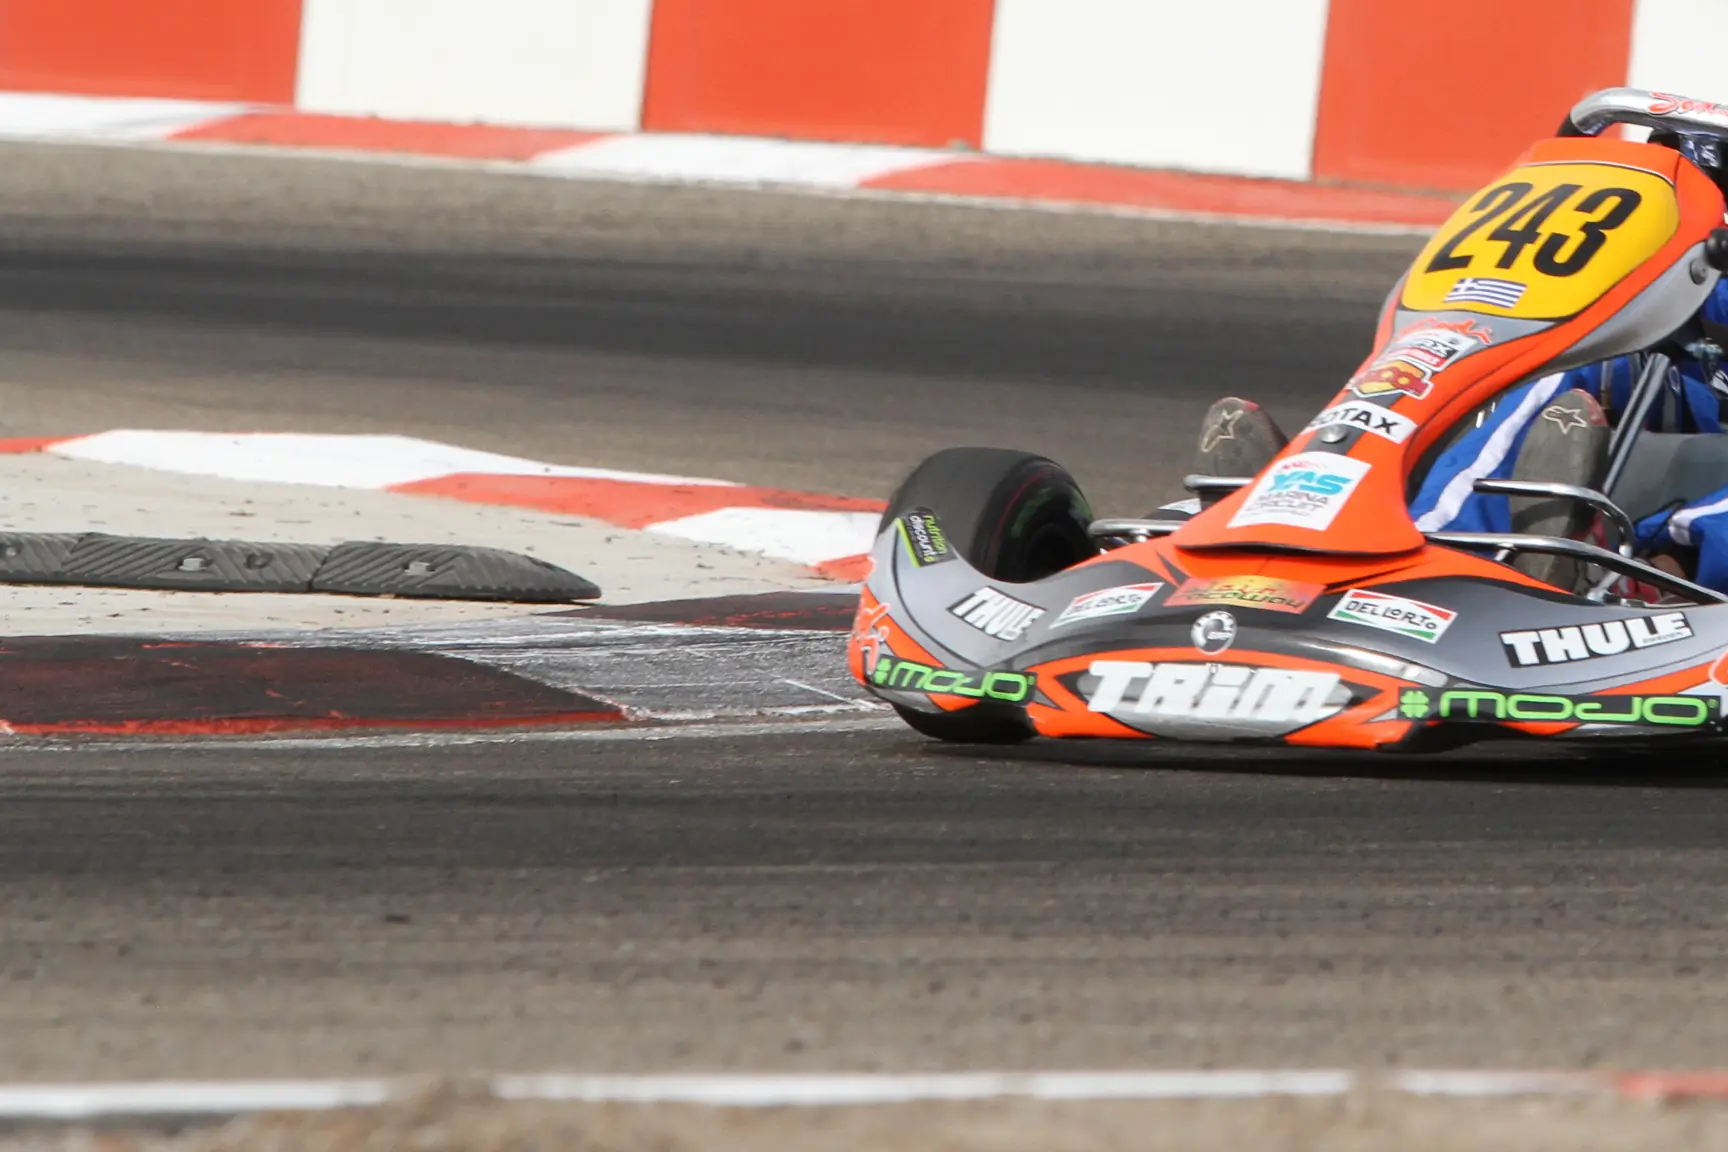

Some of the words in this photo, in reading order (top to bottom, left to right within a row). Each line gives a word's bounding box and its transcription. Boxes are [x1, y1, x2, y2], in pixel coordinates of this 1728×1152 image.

[1424, 181, 1643, 278] 243
[1268, 470, 1354, 496] YAS
[1500, 611, 1694, 666] THULE
